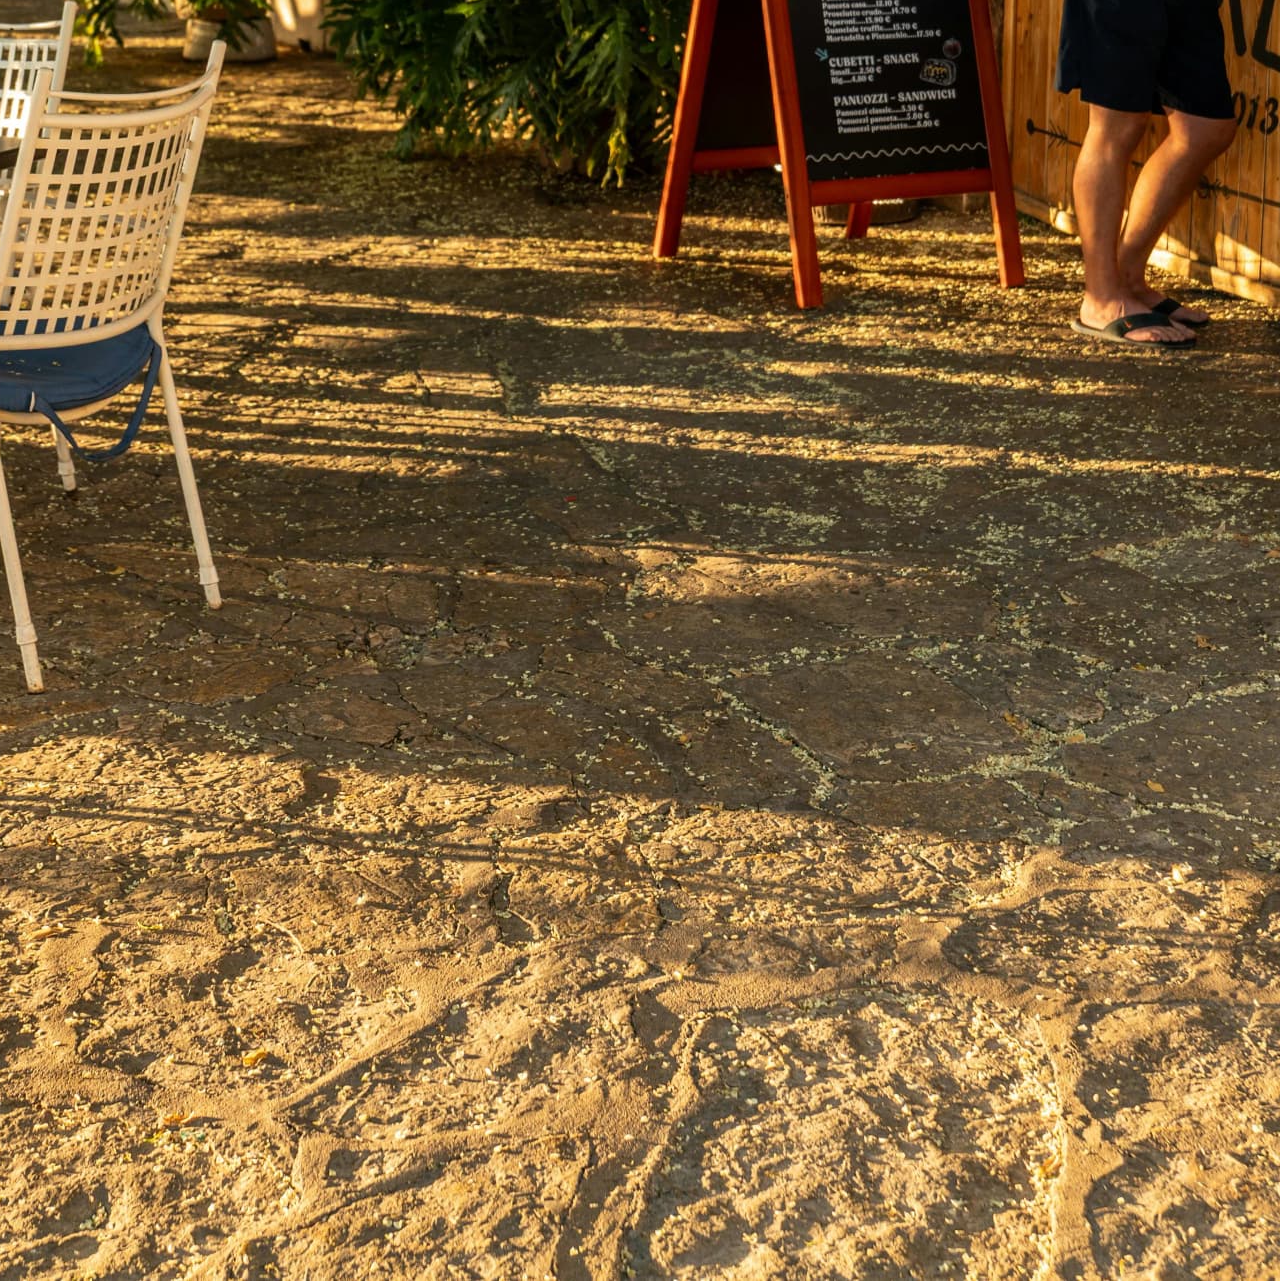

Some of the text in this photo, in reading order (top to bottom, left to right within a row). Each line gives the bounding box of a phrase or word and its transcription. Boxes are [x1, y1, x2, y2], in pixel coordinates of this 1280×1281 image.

[829, 55, 875, 67] CUBETTI
[883, 53, 920, 65] SNACK
[833, 93, 888, 107] PANUOZZI
[898, 89, 956, 102] SANDWICH
